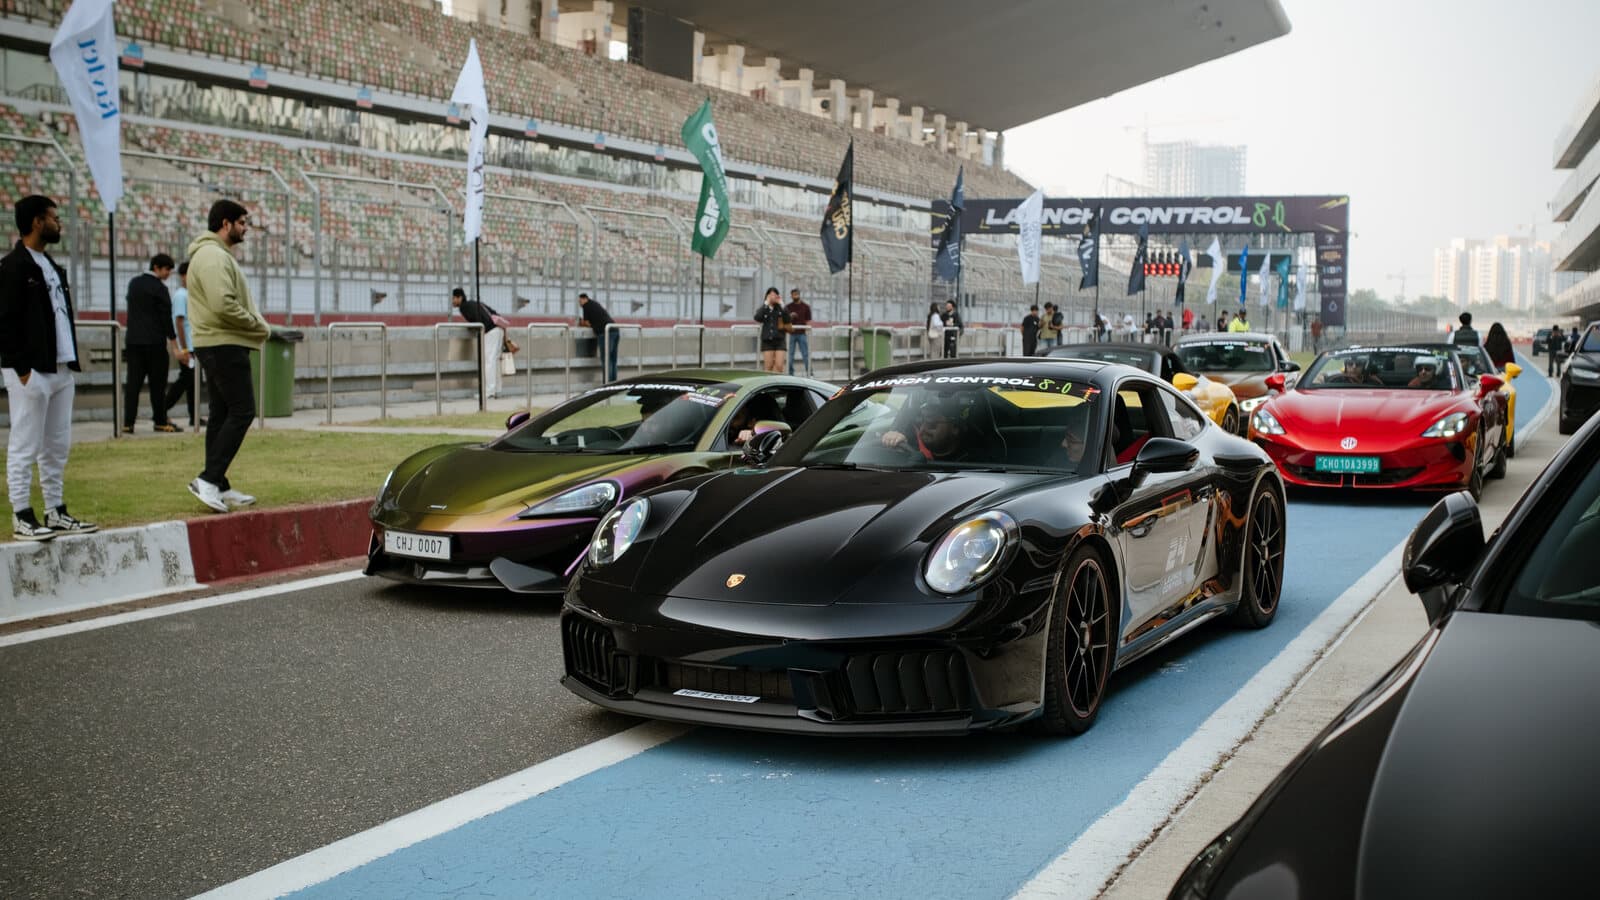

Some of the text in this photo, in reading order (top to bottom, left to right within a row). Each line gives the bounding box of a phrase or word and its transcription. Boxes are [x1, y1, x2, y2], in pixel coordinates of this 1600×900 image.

[985, 207, 1104, 225] LANCH
[1109, 206, 1251, 225] CONTROL
[851, 377, 930, 391] LAUNCH
[935, 376, 1035, 387] CONTROL
[396, 535, 443, 554] CHJ 0007
